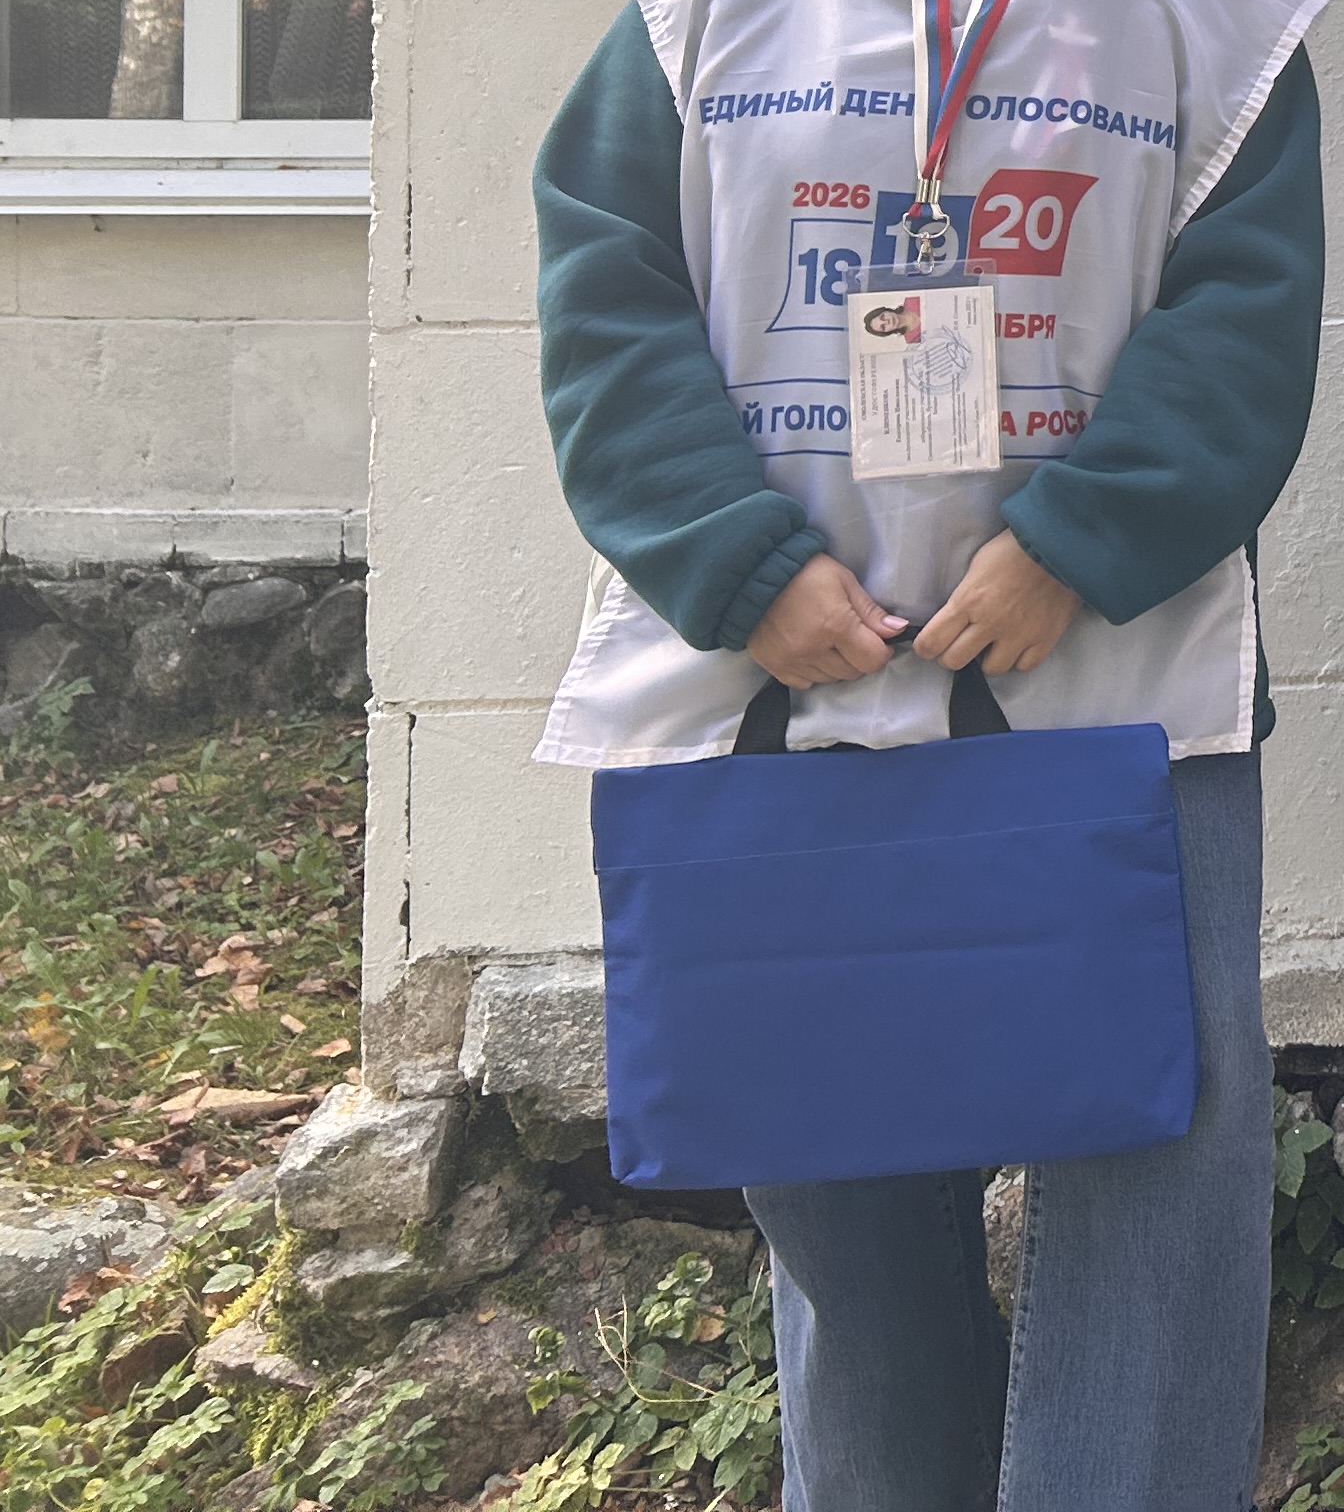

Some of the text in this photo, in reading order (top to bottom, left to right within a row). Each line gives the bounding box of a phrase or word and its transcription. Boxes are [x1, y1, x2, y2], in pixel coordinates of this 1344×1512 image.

[700, 80, 1176, 152] ЕДИНЫЙ ДЕН ОЛОСОВАНИ
[791, 182, 871, 209] 2026
[797, 193, 1064, 306] 18 19 20
[771, 404, 848, 433] ГОЛО
[1026, 409, 1088, 436] РОСС
